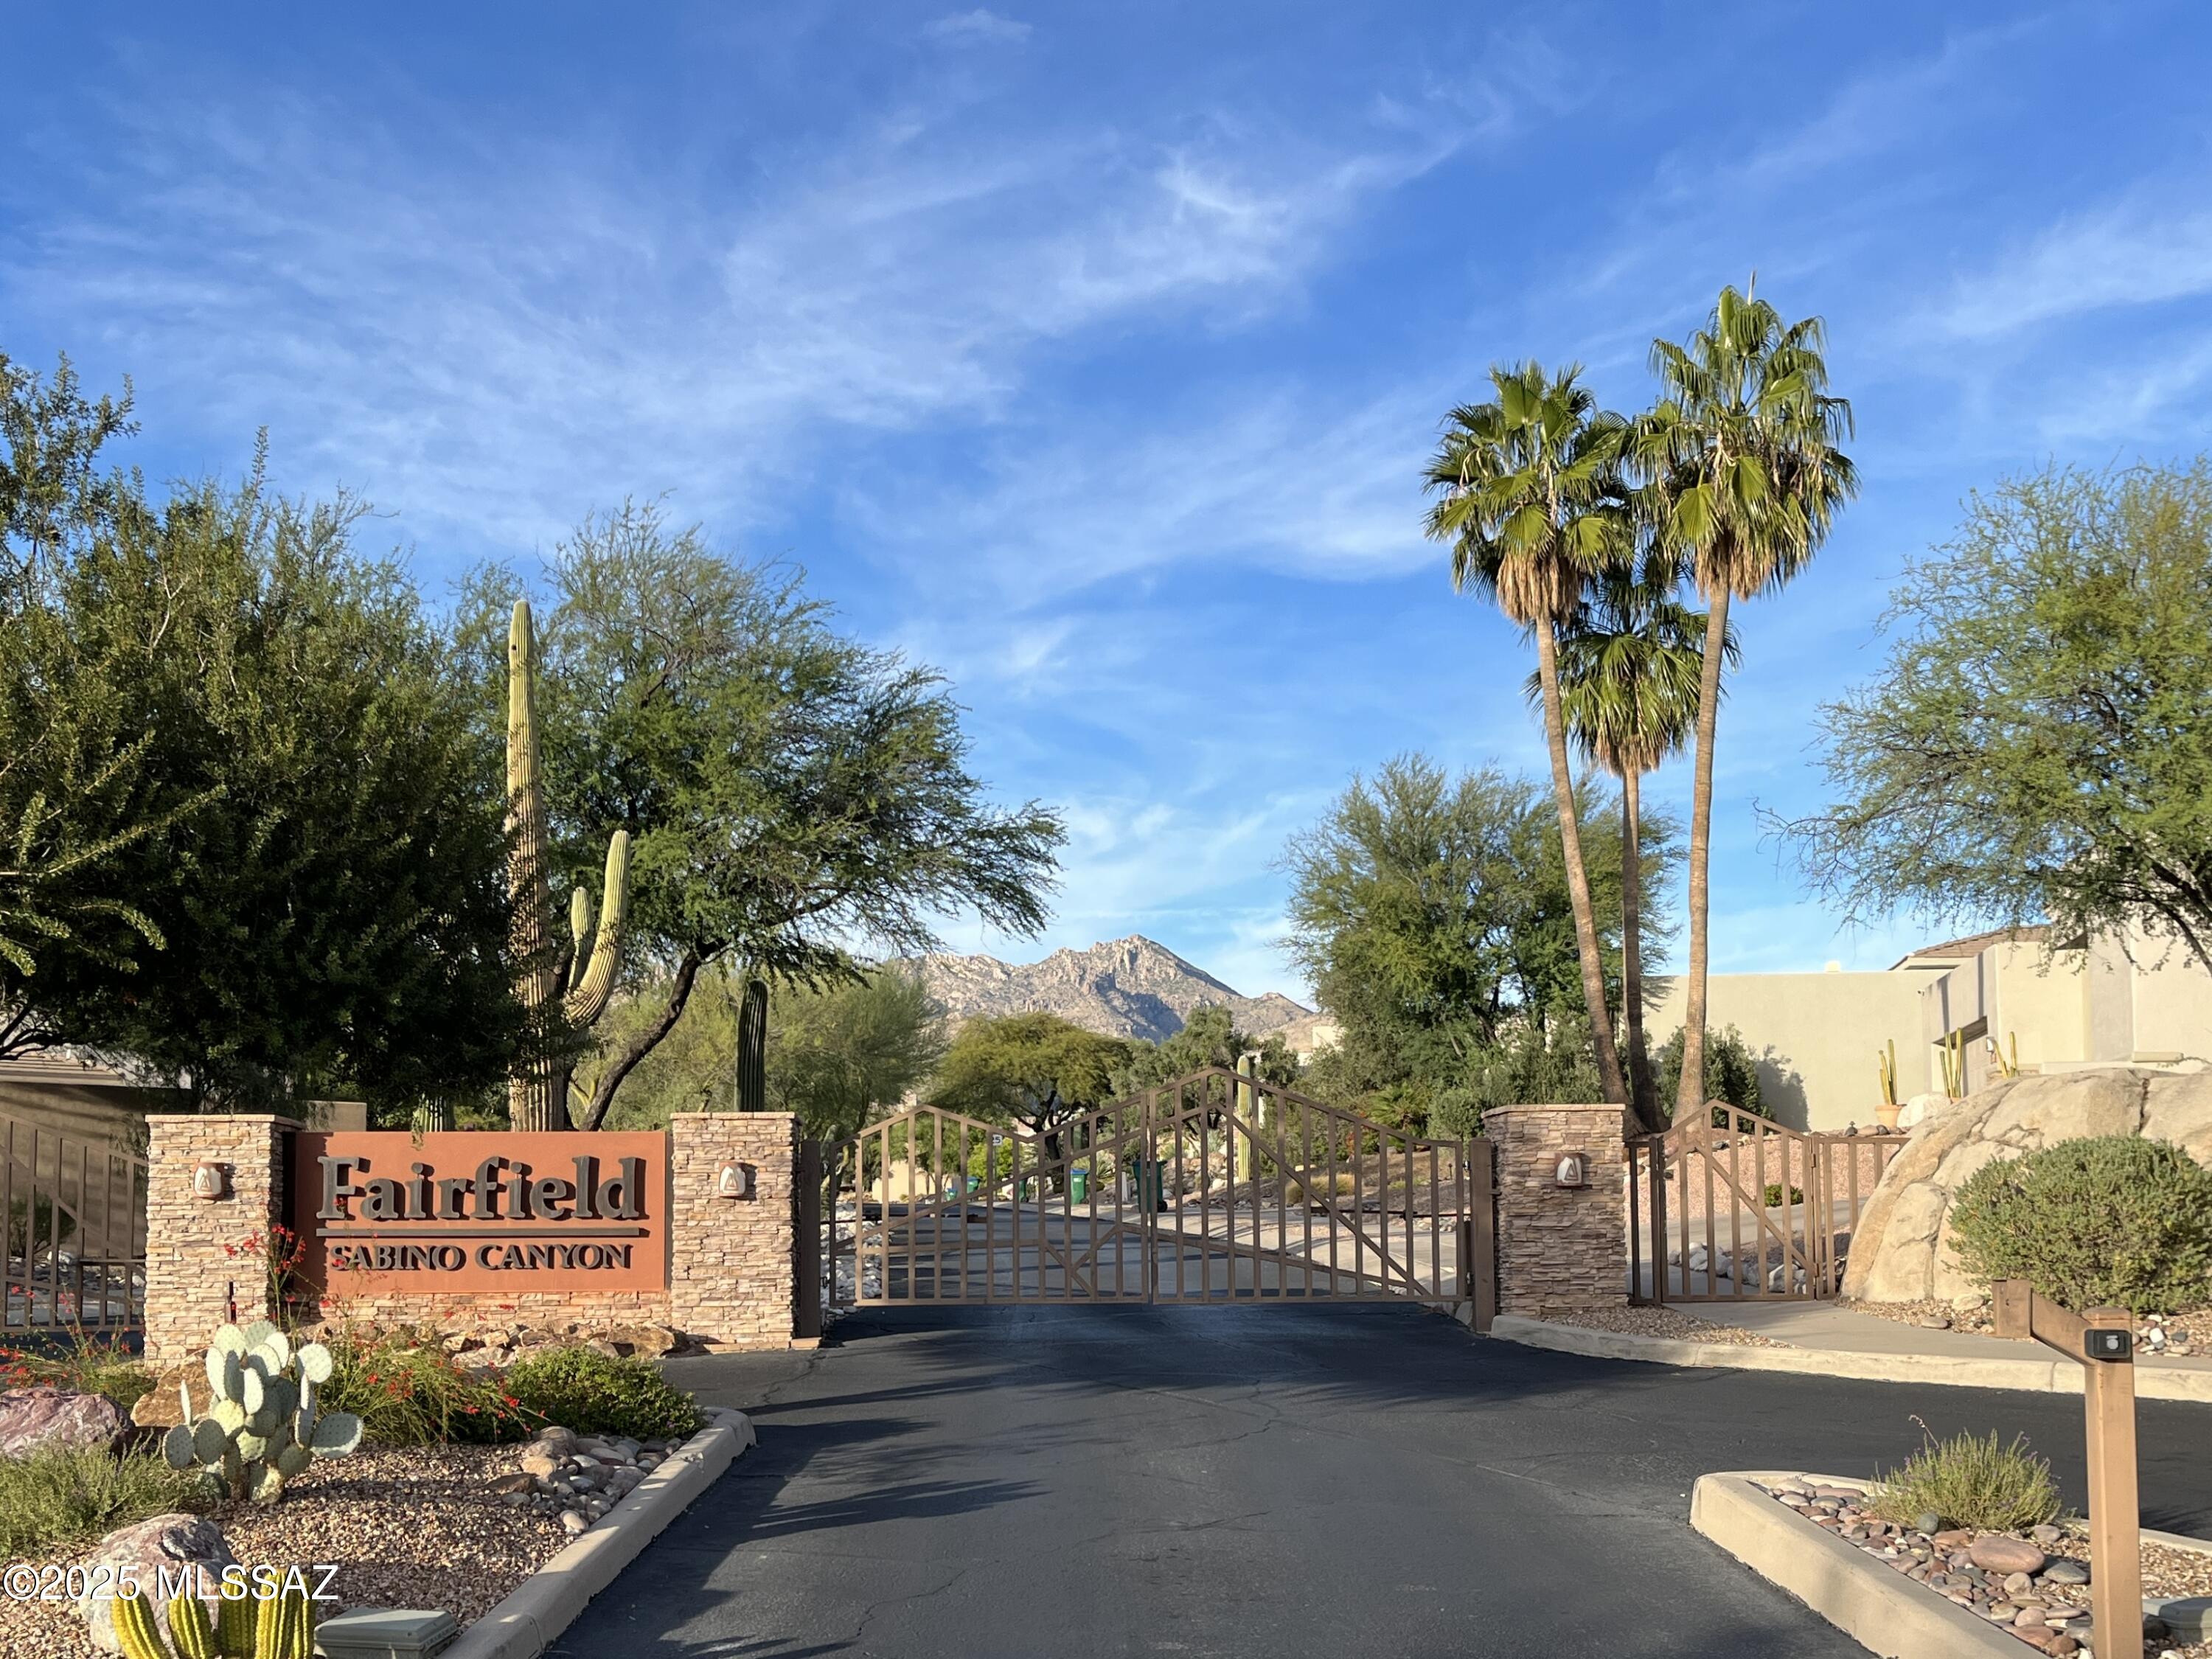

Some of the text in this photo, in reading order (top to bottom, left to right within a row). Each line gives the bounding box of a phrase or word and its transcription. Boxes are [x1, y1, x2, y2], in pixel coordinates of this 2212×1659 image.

[316, 1155, 645, 1220] Fairfield
[331, 1244, 632, 1270] SABINO CANYON
